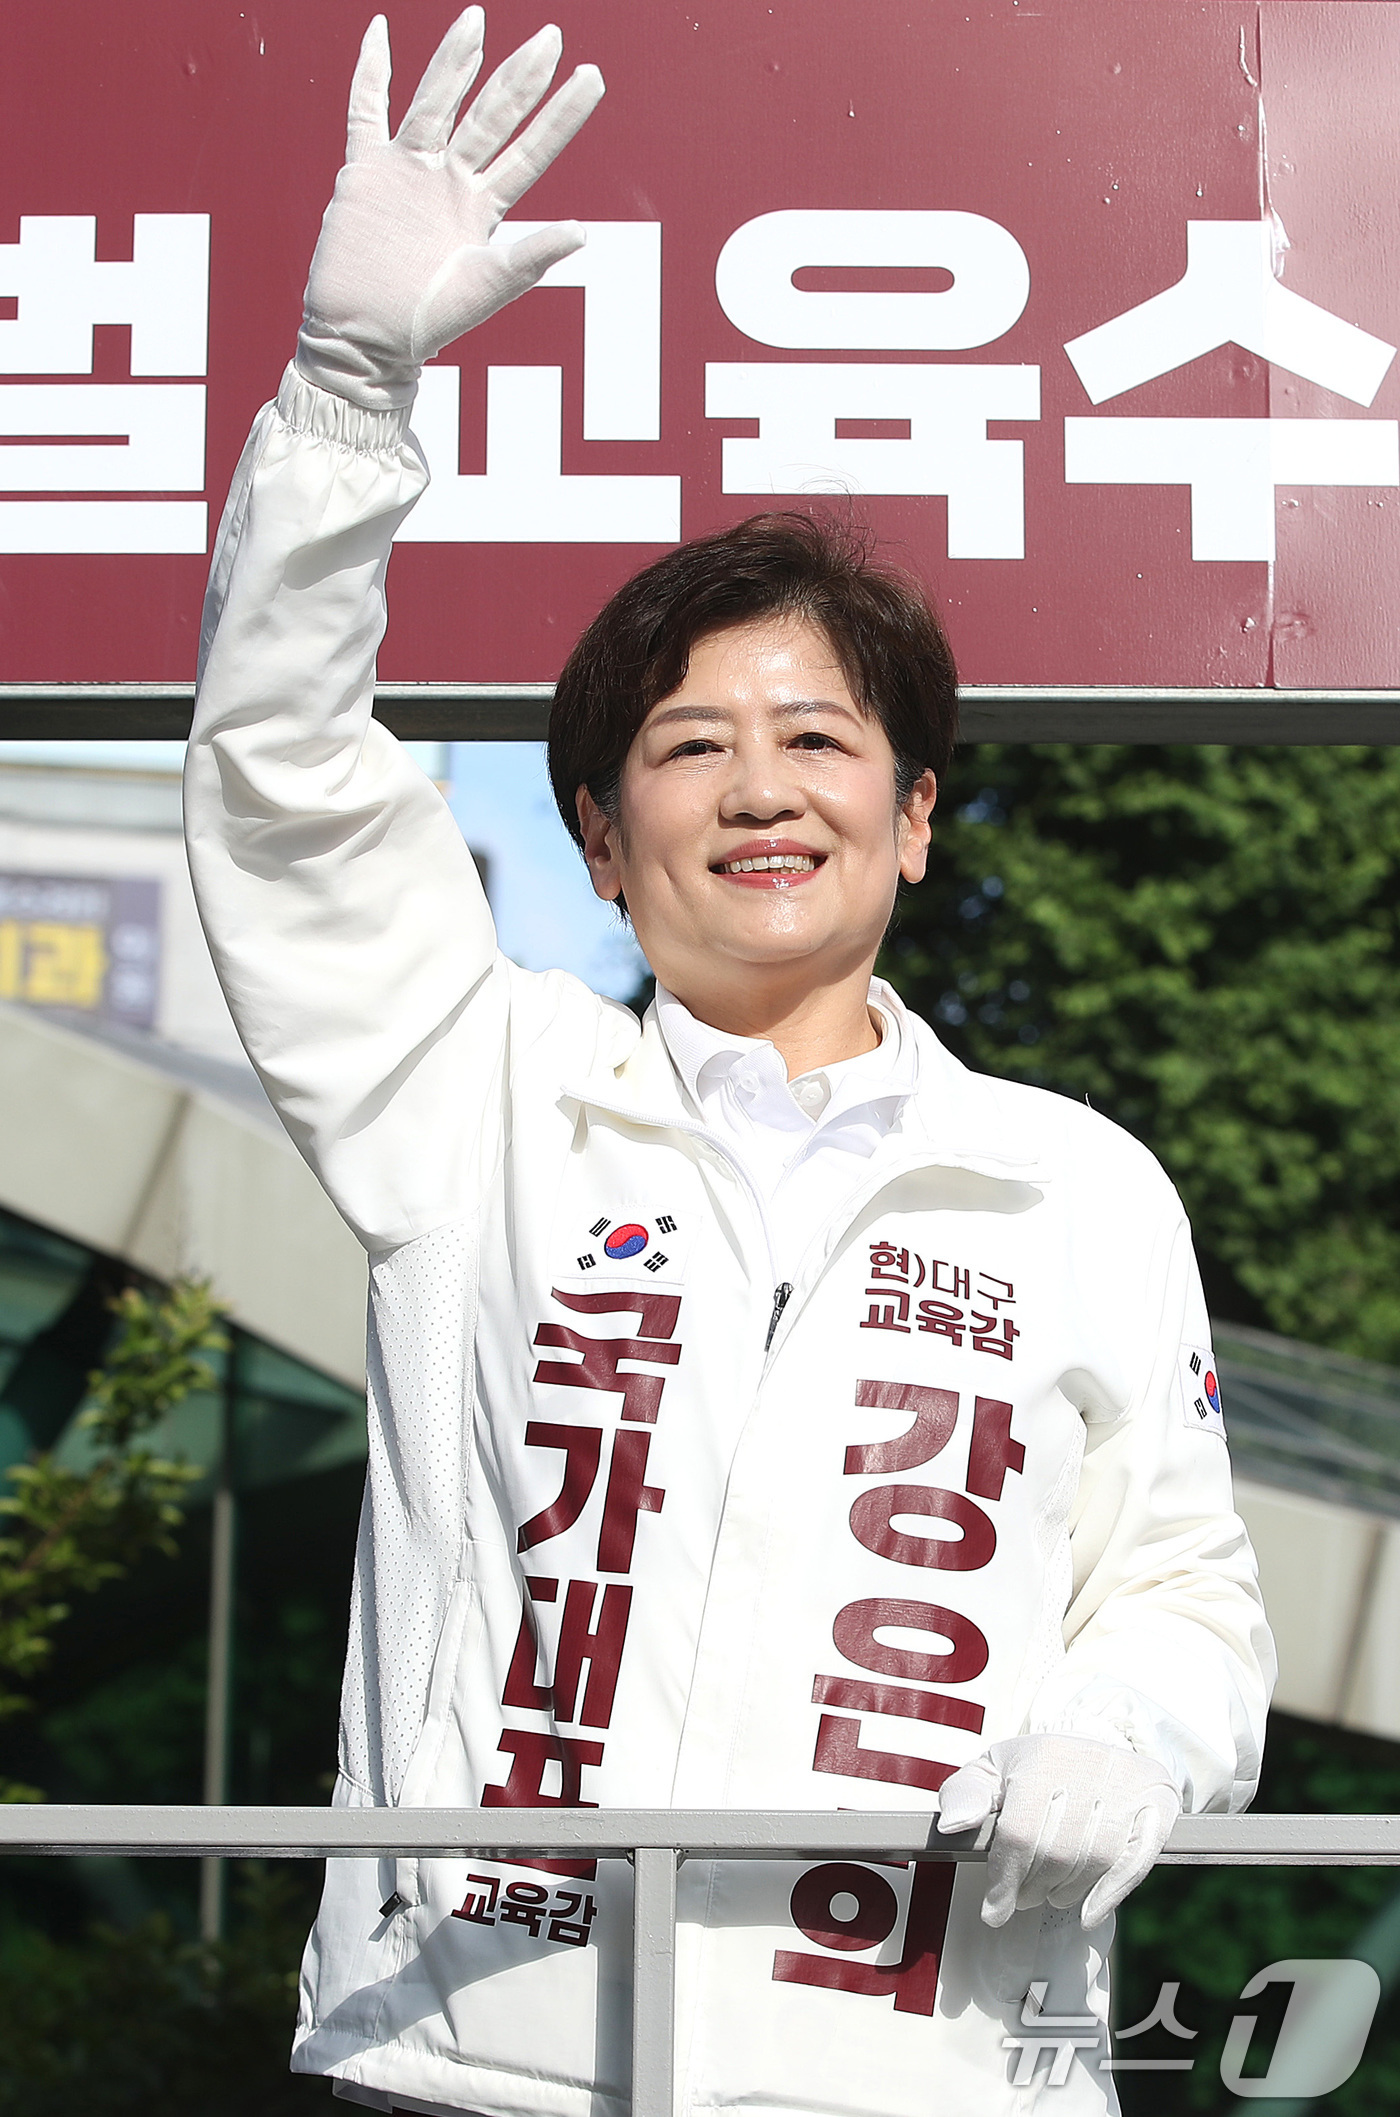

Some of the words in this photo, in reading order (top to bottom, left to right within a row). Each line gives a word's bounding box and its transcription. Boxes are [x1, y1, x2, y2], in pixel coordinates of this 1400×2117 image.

[391, 208, 1399, 562] 교육수
[869, 1241, 1017, 1311] 현)대구
[859, 1288, 1021, 1362] 교육감
[450, 1873, 598, 1948] 교육감
